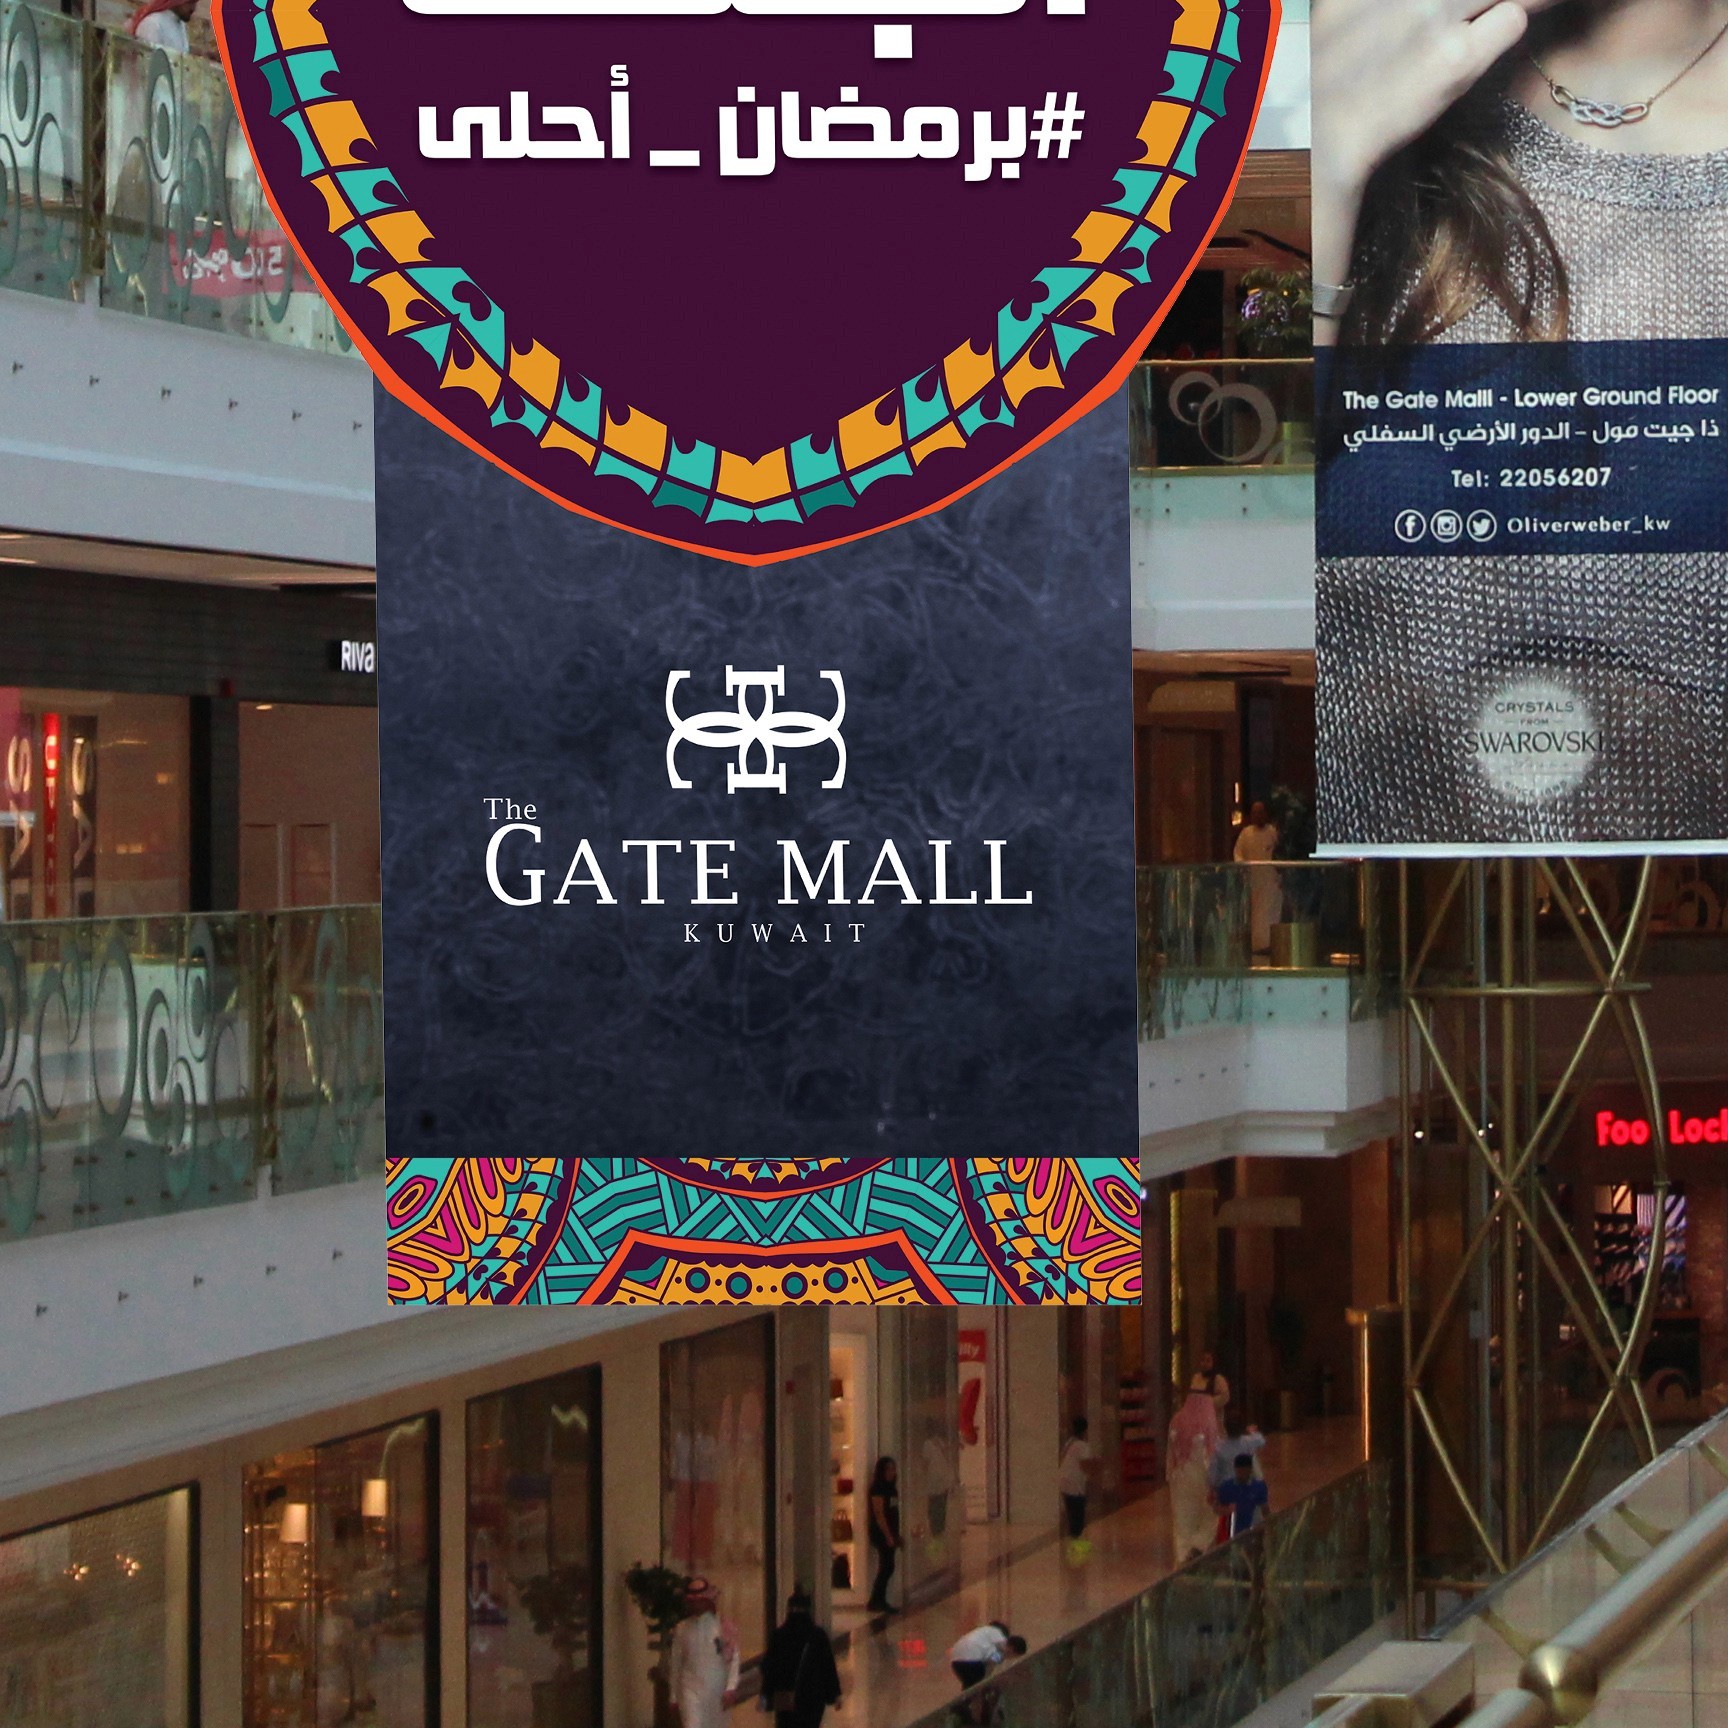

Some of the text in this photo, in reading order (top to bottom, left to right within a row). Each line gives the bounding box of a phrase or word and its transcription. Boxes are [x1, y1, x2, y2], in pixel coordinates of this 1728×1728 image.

[1343, 389, 1380, 410] The
[1385, 389, 1439, 409] Gate
[1514, 387, 1577, 408] Lower
[1582, 386, 1662, 406] Ground
[1668, 385, 1719, 405] Floor
[1343, 423, 1434, 453] السفلي
[1438, 420, 1516, 452] الأرضي
[1520, 421, 1570, 445] الدور
[1592, 421, 1639, 444] مول
[1643, 422, 1695, 443] جيت
[1701, 419, 1720, 437] ذا
[1450, 466, 1612, 488] Tel: 22056207
[1506, 514, 1672, 534] Oliverweber_kw
[1494, 701, 1575, 714] CRYSTALS
[1463, 730, 1604, 754] SWAROVSKI
[483, 797, 537, 821] The
[776, 838, 1033, 905] MALL
[684, 923, 865, 944] KUWAIT
[1596, 1109, 1651, 1147] Foo
